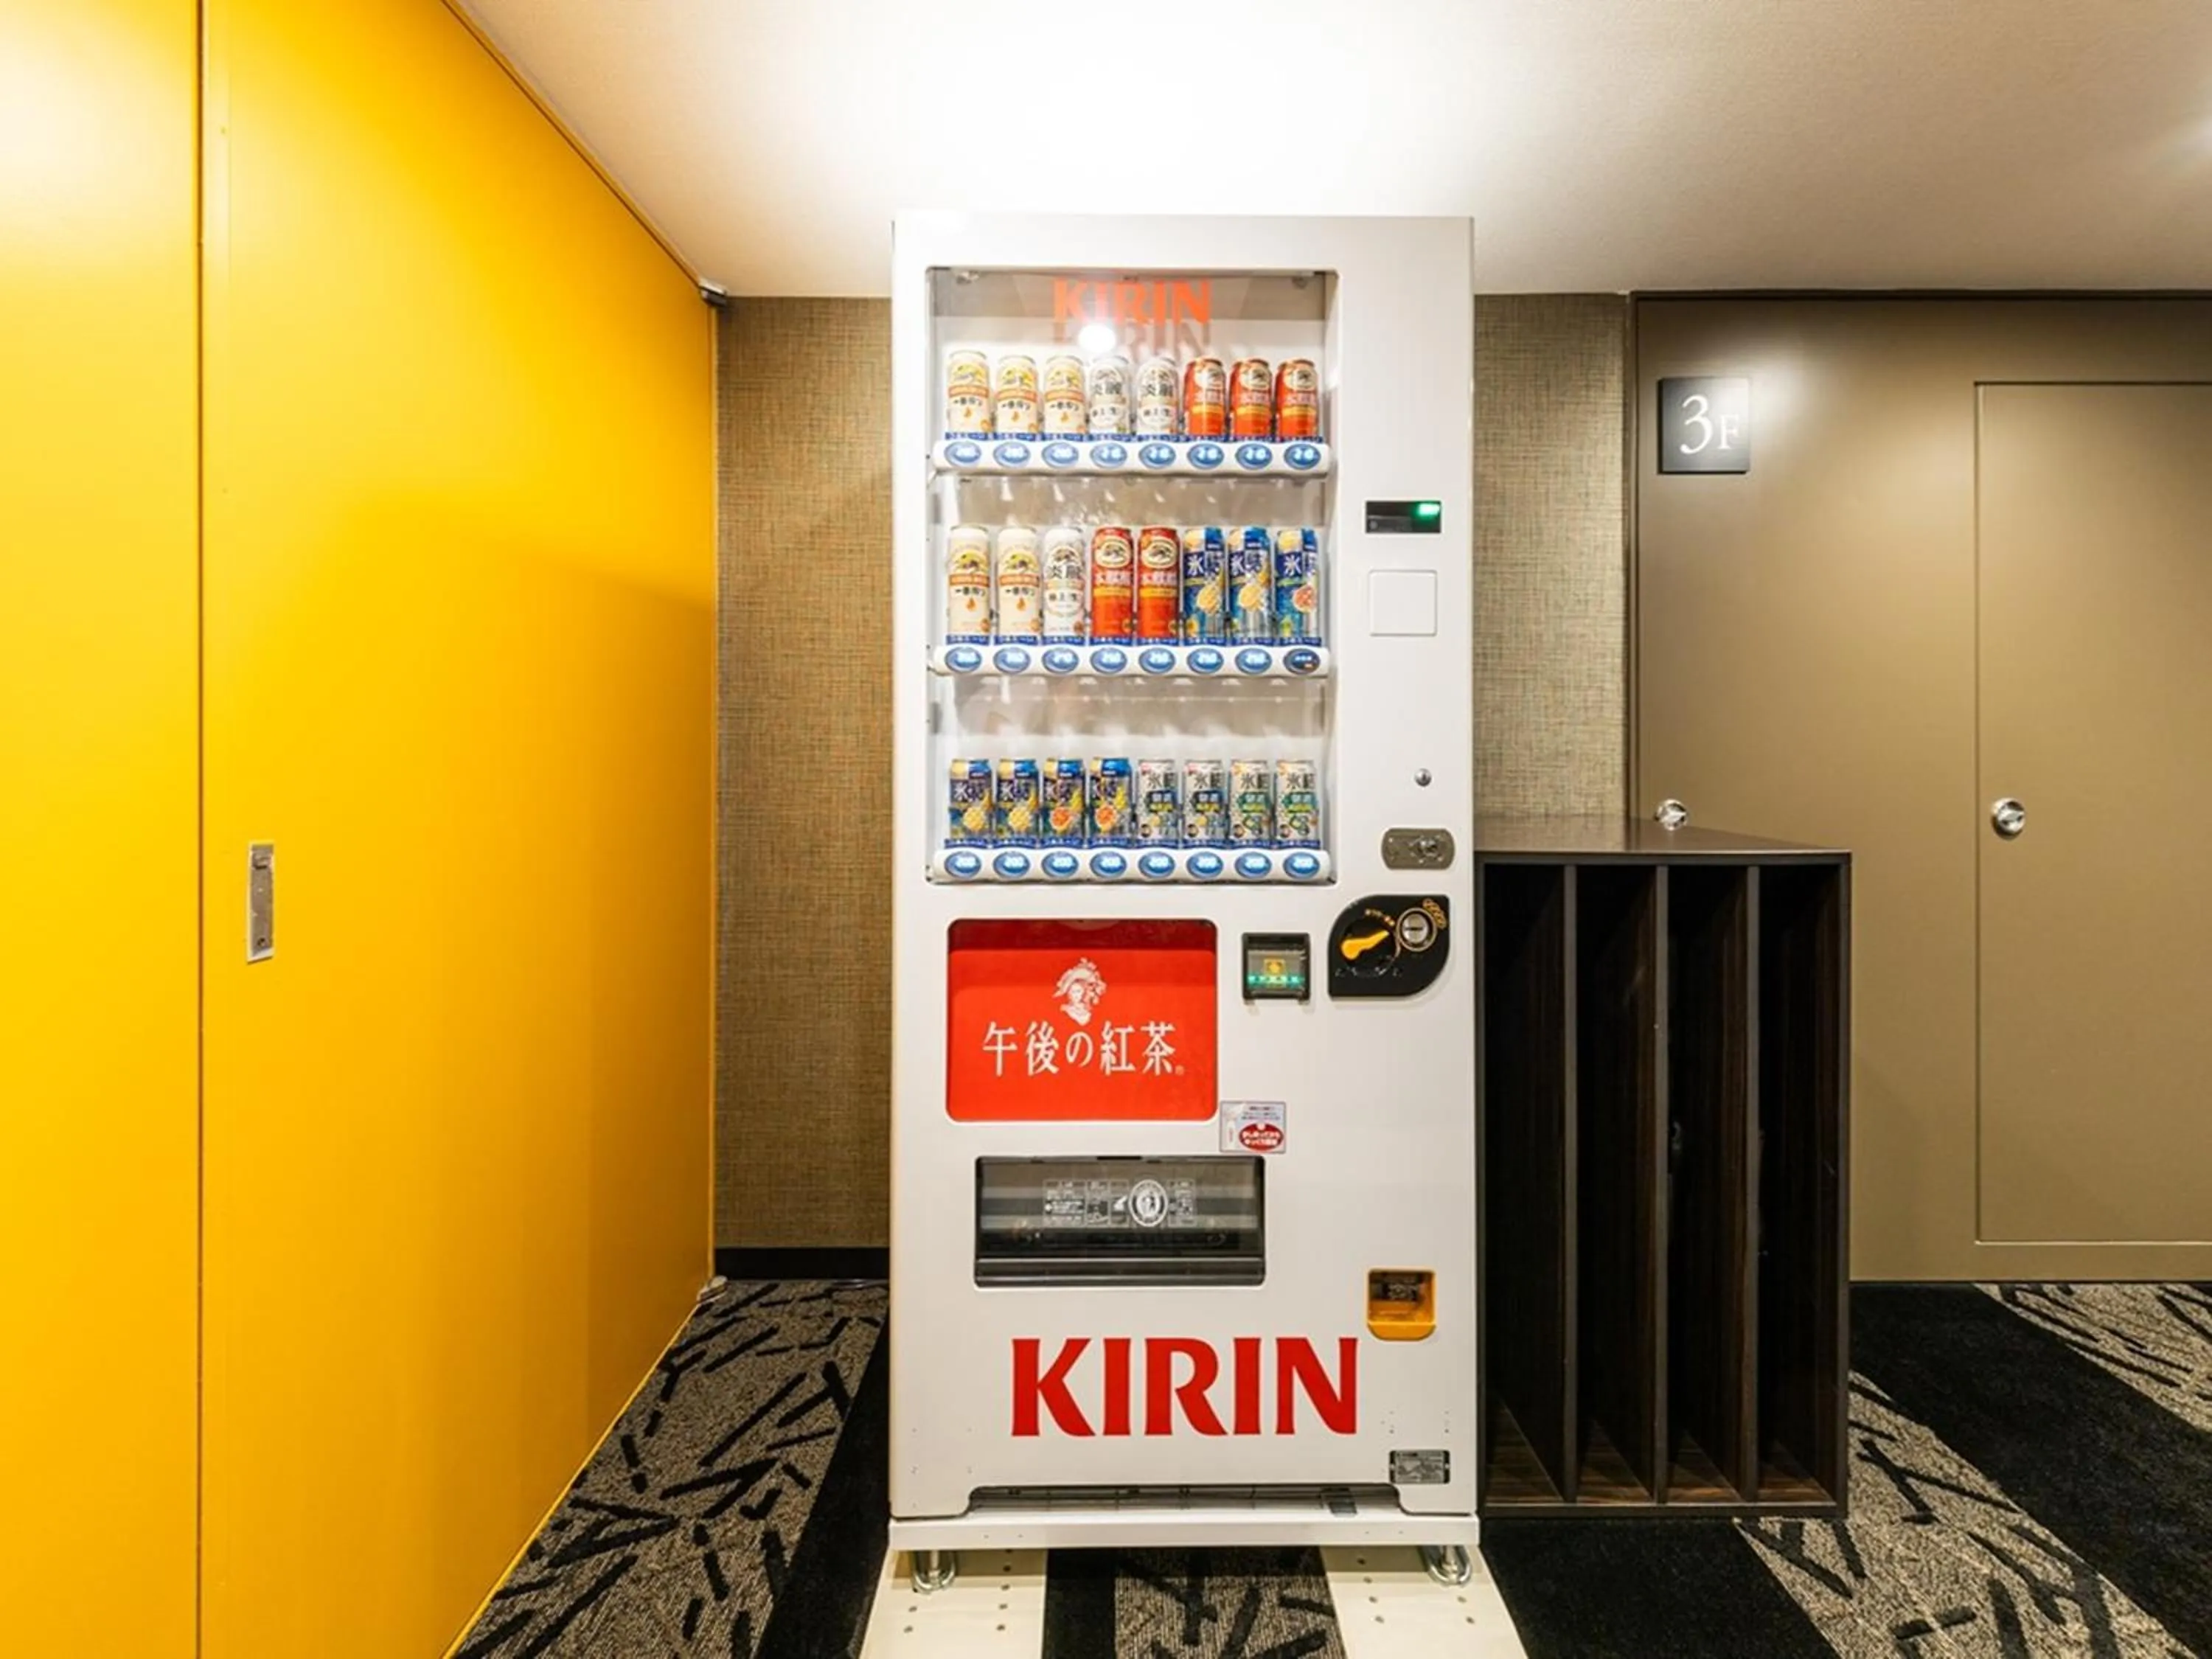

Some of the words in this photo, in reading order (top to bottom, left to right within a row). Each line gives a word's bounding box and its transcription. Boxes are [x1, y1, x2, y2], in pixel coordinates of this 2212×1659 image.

[1053, 277, 1212, 324] KIRIN
[1680, 394, 1740, 454] 3F
[983, 1020, 1177, 1077] 午後の紅茶
[1011, 1337, 1359, 1437] KIRIN
